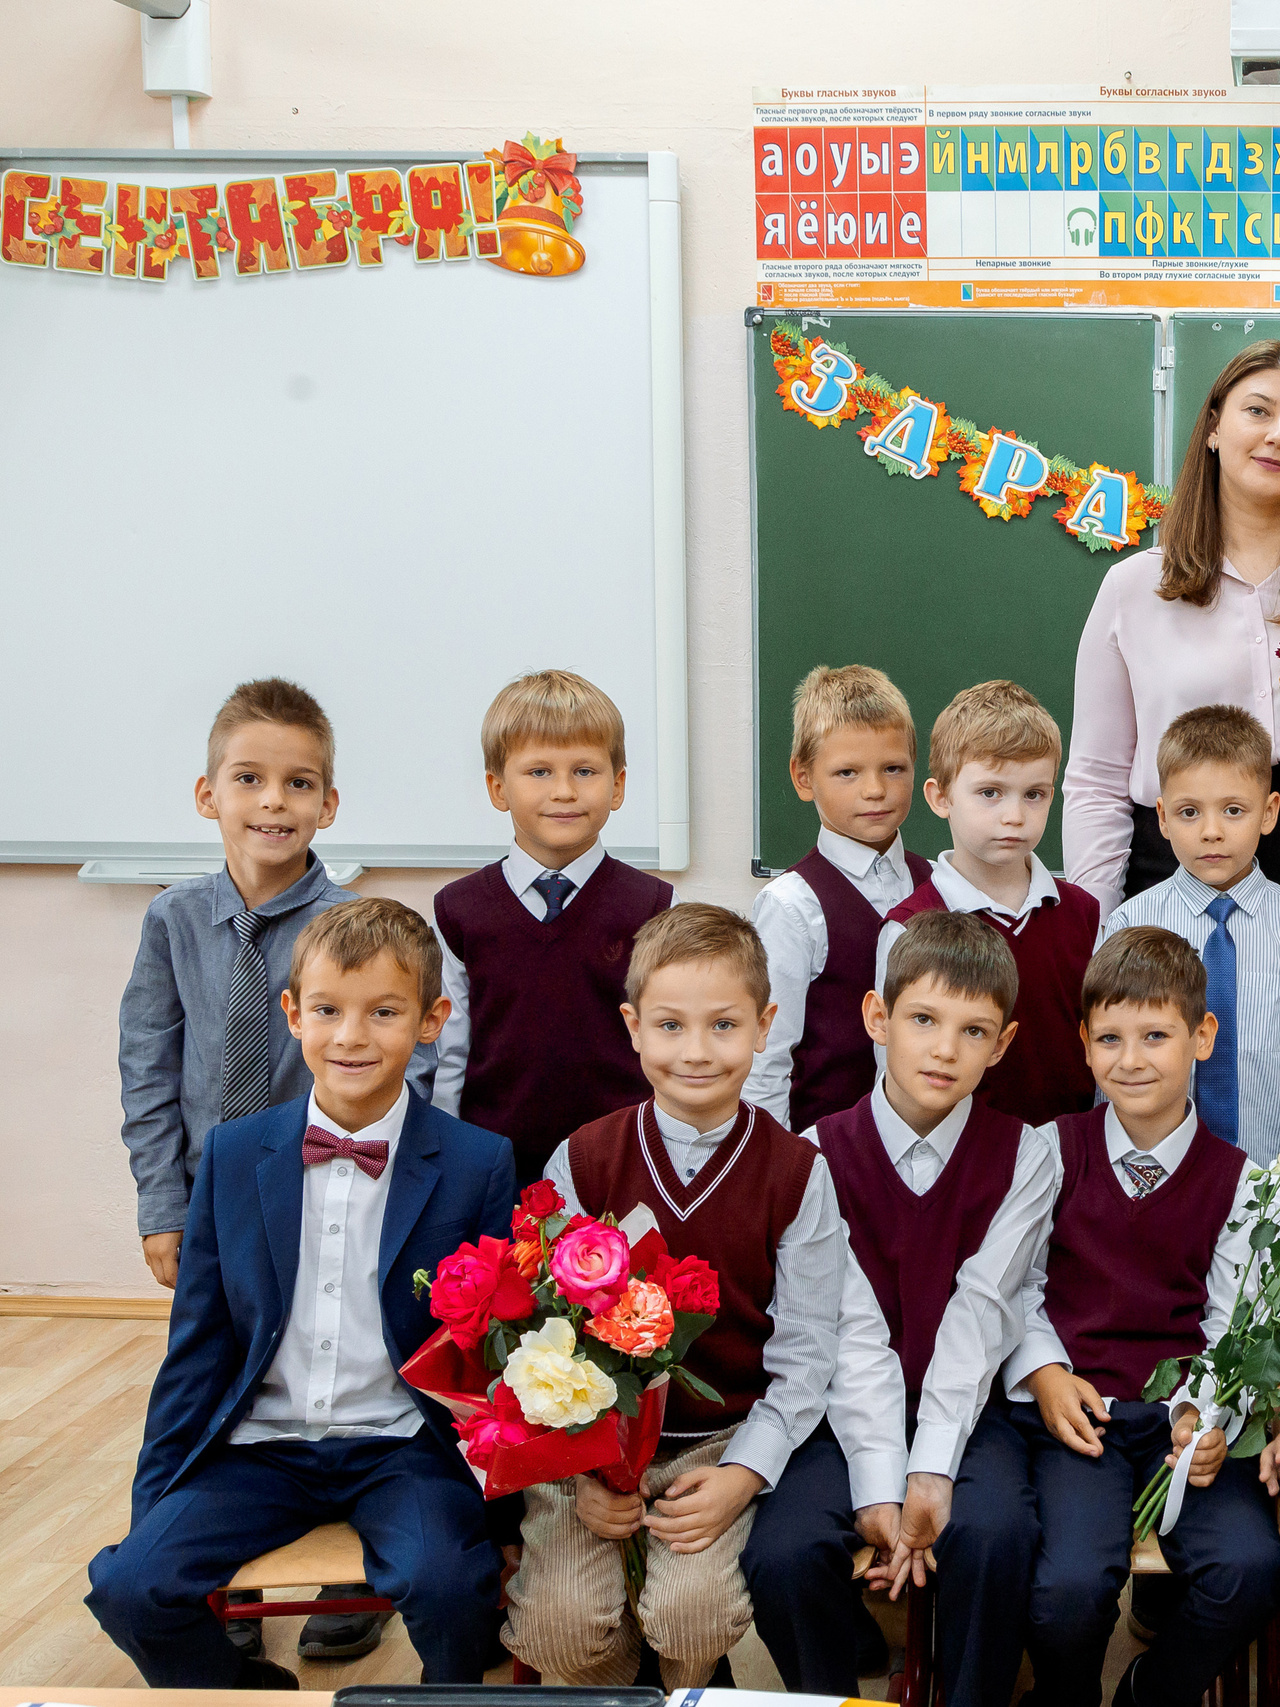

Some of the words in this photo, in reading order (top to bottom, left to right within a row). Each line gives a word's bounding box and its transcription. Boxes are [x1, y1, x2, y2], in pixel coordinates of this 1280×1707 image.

[781, 88, 814, 100] Буквы
[817, 89, 859, 98] гласных
[862, 89, 897, 99] звуков
[1100, 86, 1132, 98] Буквы
[1135, 88, 1189, 98] согласных
[1192, 88, 1227, 99] звуков
[756, 107, 786, 115] Гласные
[788, 108, 818, 116] первого
[819, 108, 838, 116] ряда
[839, 107, 883, 115] обозначают
[885, 107, 923, 115] твёрдость
[928, 109, 935, 118] В
[936, 111, 967, 119] первом
[968, 110, 989, 119] ряду
[1025, 109, 1067, 117] согласные
[1068, 110, 1092, 118] звуки
[886, 115, 918, 123] следуют
[1, 160, 502, 282] СЕНТЯБРЯ!
[793, 263, 823, 271] второго
[825, 263, 843, 271] ряда
[889, 262, 923, 270] мягкость
[976, 259, 1016, 268] Непарные
[1152, 260, 1184, 268] Парные
[1185, 260, 1249, 269] звонкие/глухие
[804, 271, 831, 279] звуков,
[889, 271, 920, 279] следуют
[1099, 271, 1110, 279] Во
[1143, 272, 1163, 280] ряду
[1165, 272, 1192, 280] глухие
[1237, 273, 1261, 281] звуки
